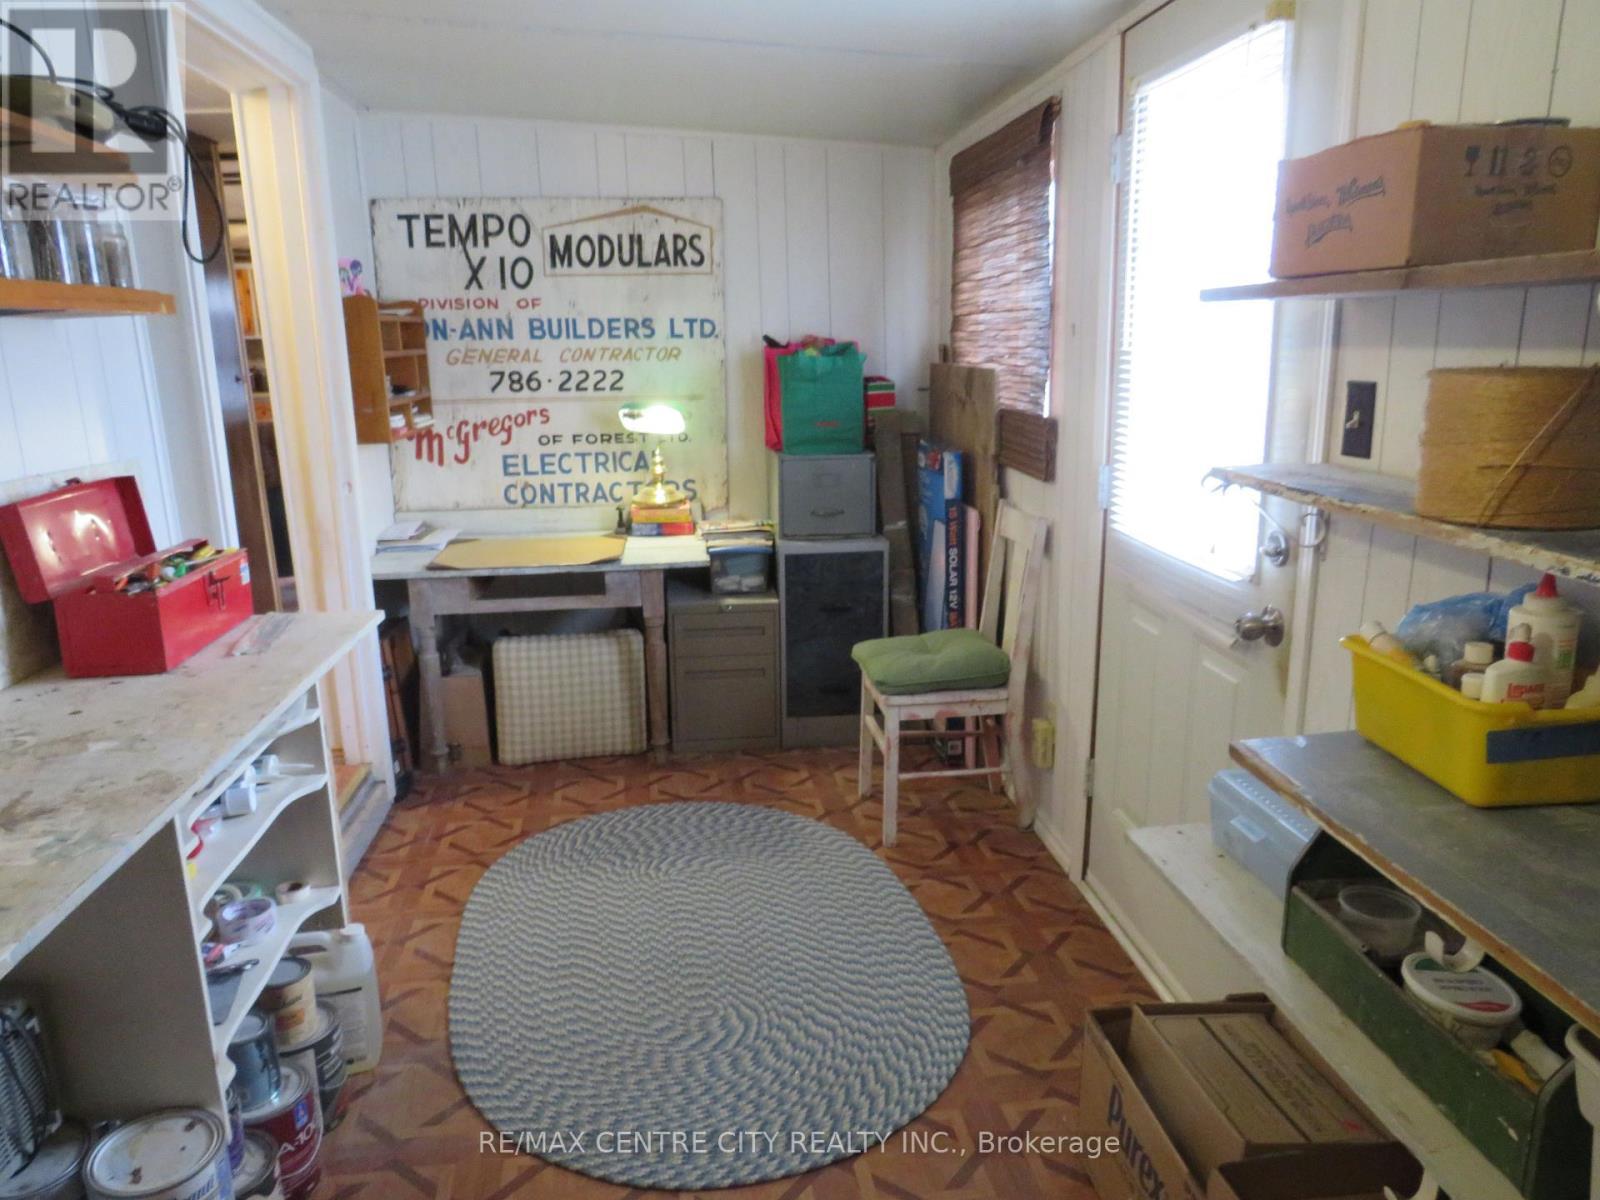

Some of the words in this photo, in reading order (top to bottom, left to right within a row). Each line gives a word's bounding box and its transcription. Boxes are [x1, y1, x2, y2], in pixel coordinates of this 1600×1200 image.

[397, 213, 532, 248] TEMPO
[549, 233, 706, 269] MODULARS
[516, 298, 542, 310] OF
[528, 317, 656, 341] BUILDERS
[669, 318, 720, 340] LTD.
[445, 348, 543, 366] GENERAL
[559, 346, 682, 363] CONTRACTOR
[538, 434, 563, 447] OF
[572, 432, 648, 446] FOREST
[502, 450, 657, 477] ELECTRICA
[503, 479, 698, 505] CONTRACTS
[949, 547, 958, 587] SOLAR
